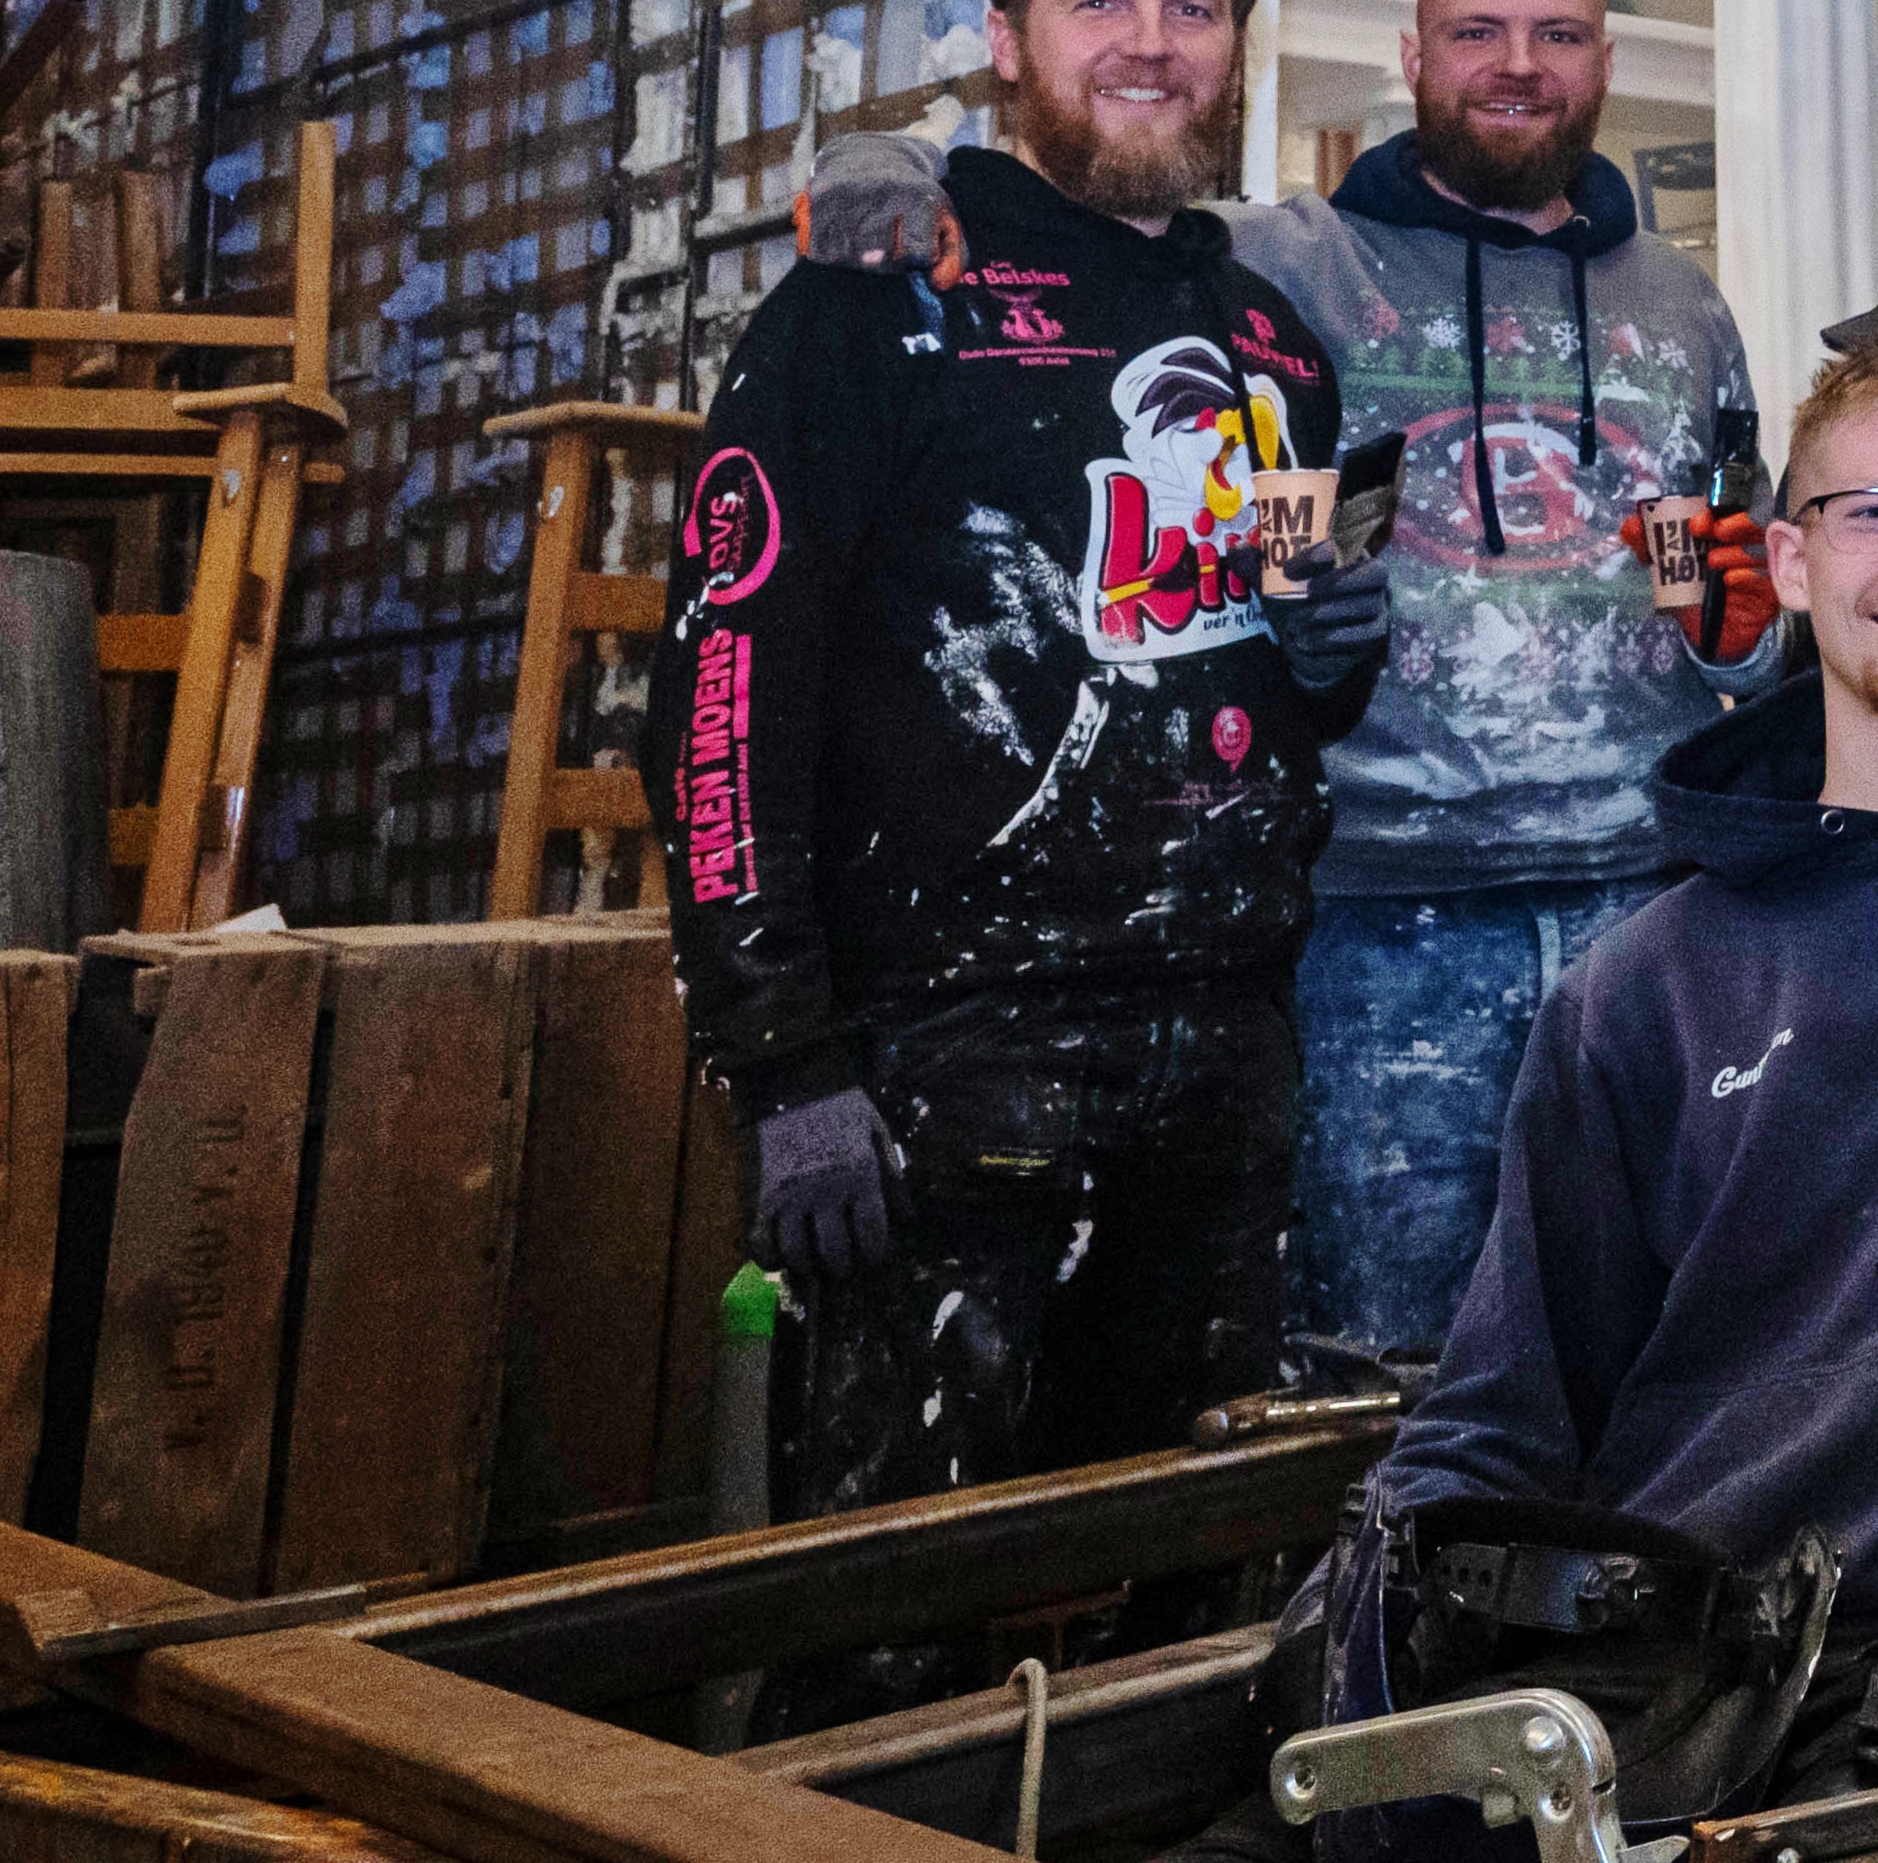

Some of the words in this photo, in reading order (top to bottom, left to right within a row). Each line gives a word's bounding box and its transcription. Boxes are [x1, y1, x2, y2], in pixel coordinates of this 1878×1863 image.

[960, 271, 979, 286] e
[691, 628, 733, 767] MOENS
[689, 770, 739, 904] PEKEN
